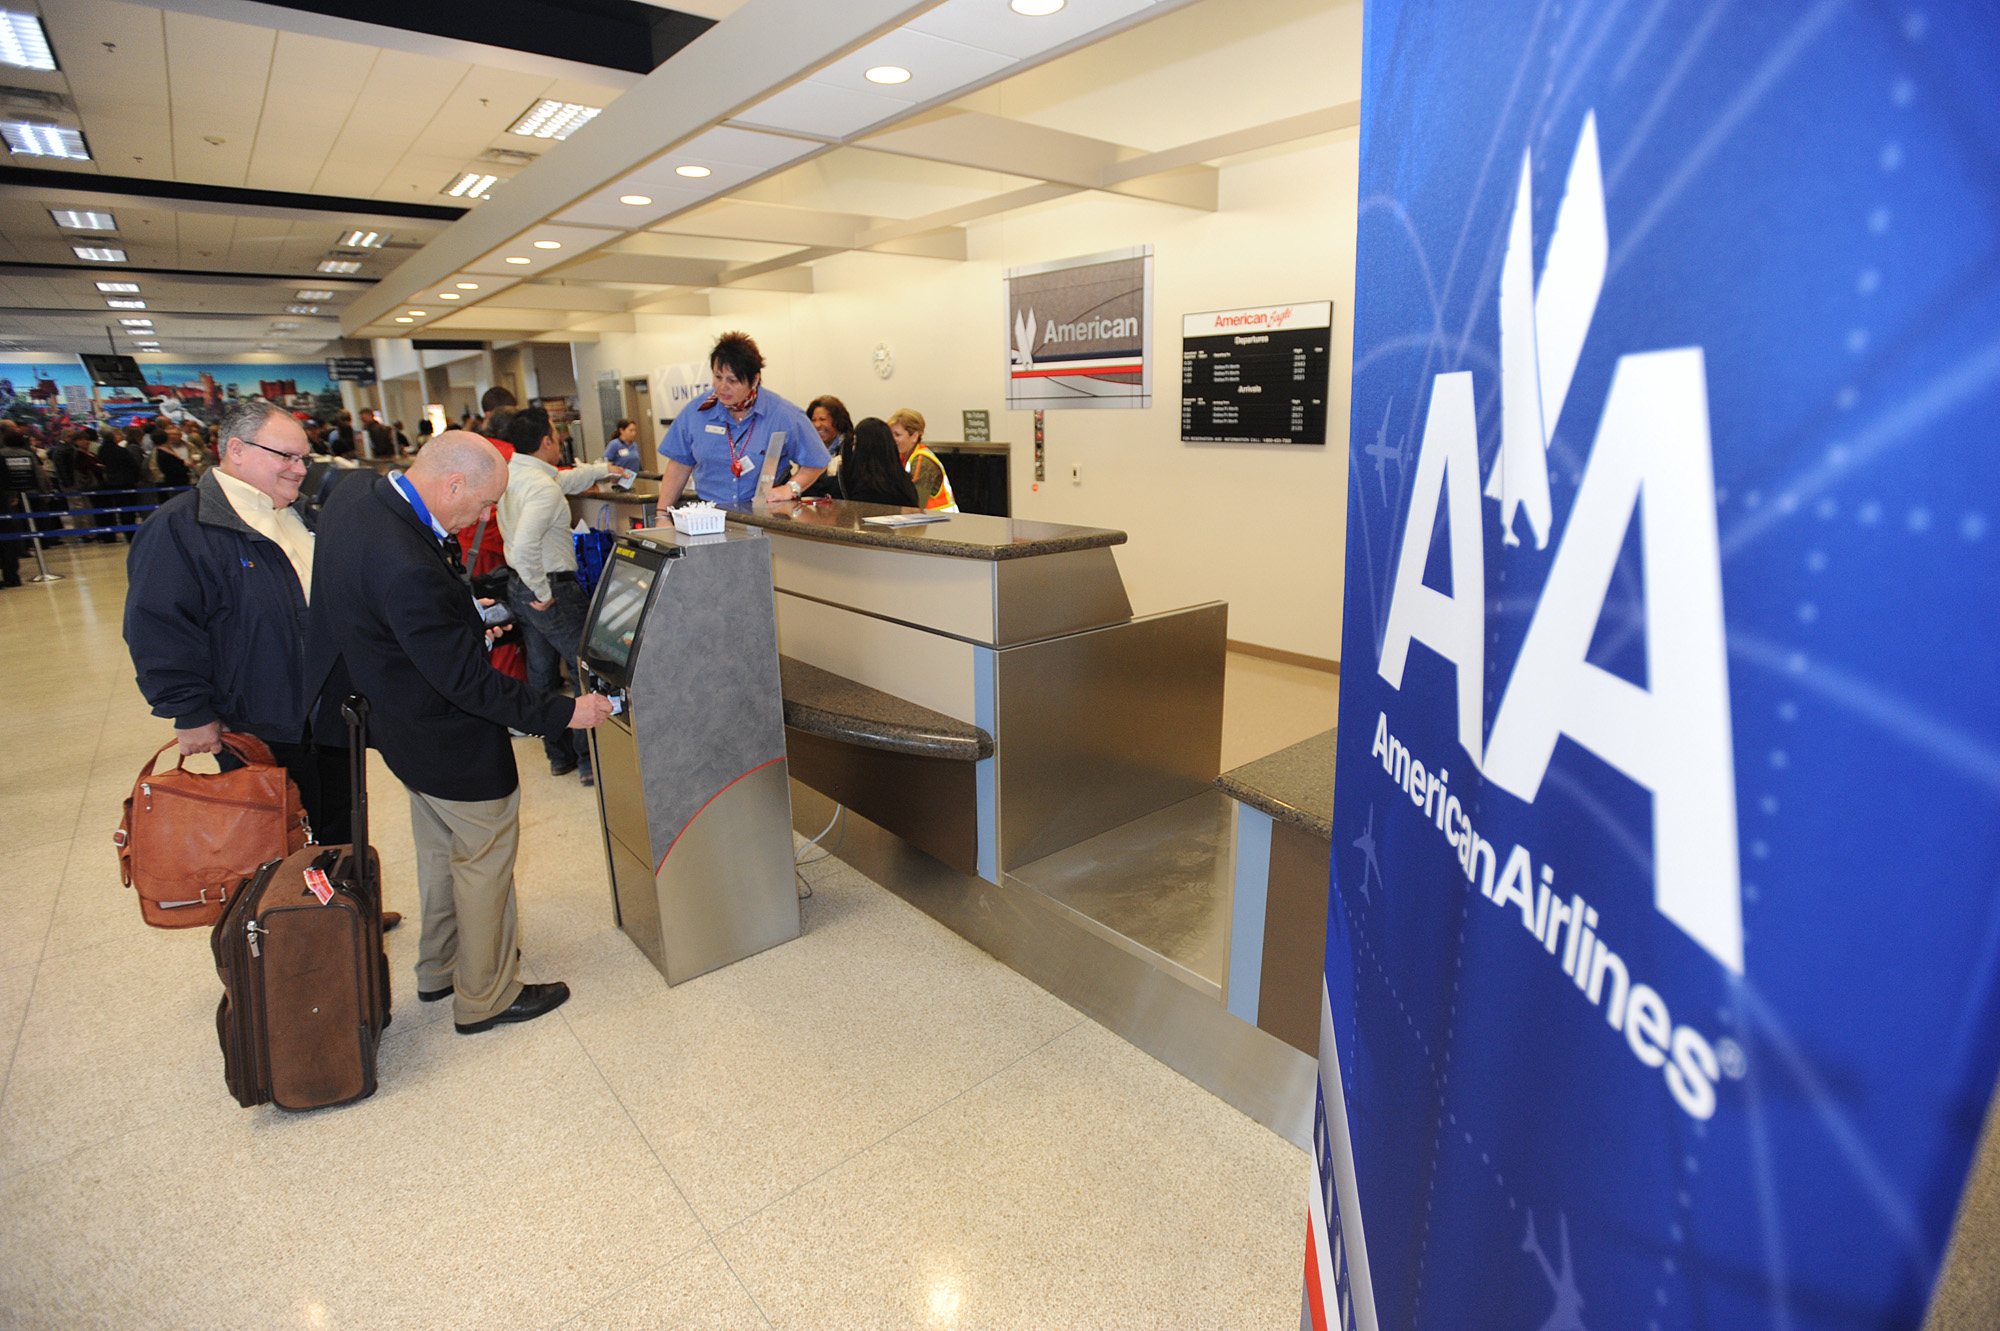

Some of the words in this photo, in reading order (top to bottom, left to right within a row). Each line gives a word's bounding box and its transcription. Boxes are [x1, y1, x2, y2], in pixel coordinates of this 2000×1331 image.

[1214, 312, 1268, 328] American
[1043, 315, 1139, 344] American
[1233, 335, 1270, 347] Departures
[671, 382, 710, 400] UNITE
[1237, 385, 1263, 394] Arrivals
